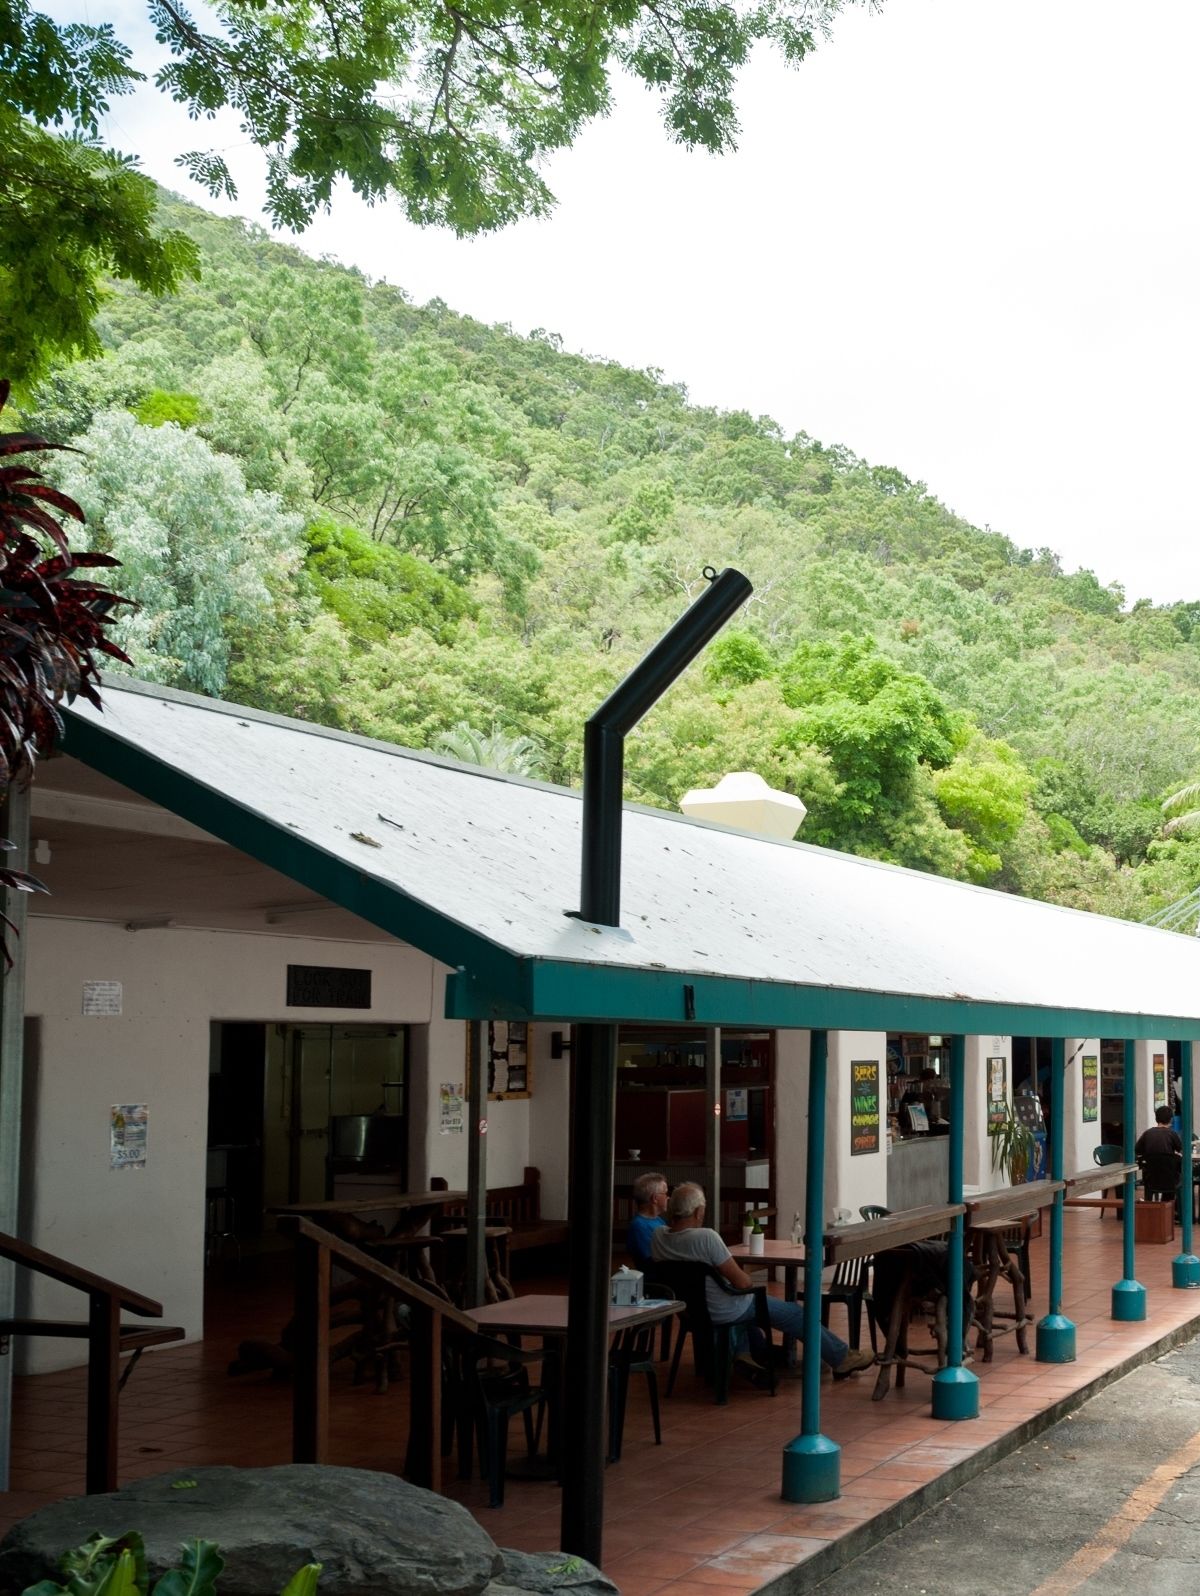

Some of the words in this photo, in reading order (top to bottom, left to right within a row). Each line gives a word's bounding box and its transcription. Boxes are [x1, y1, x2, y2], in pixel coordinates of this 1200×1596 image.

[294, 970, 331, 987] LOOK
[294, 986, 321, 1004] FOR
[854, 1065, 878, 1082] BEERS
[854, 1095, 878, 1114] WINES
